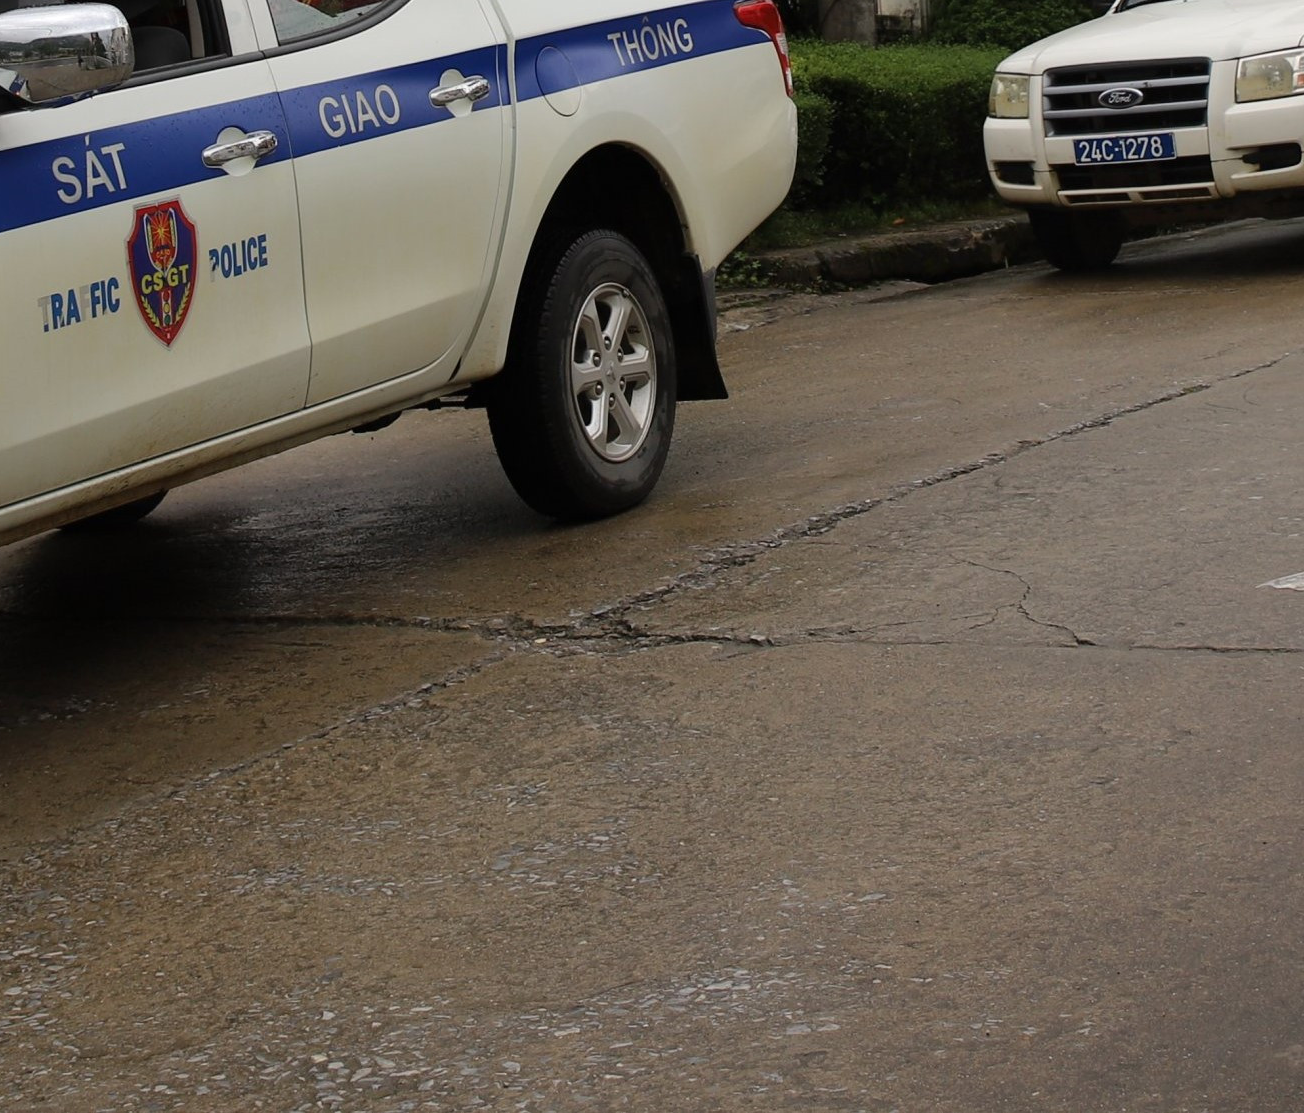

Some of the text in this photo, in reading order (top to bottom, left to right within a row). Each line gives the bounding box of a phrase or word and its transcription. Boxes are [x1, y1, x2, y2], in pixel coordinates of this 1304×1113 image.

[51, 134, 130, 206] SÁT
[317, 83, 401, 140] GIAO
[605, 15, 694, 67] THÔNG
[1108, 91, 1132, 104] Ford
[1079, 137, 1164, 163] 24C-1278
[208, 233, 269, 283] POLICE
